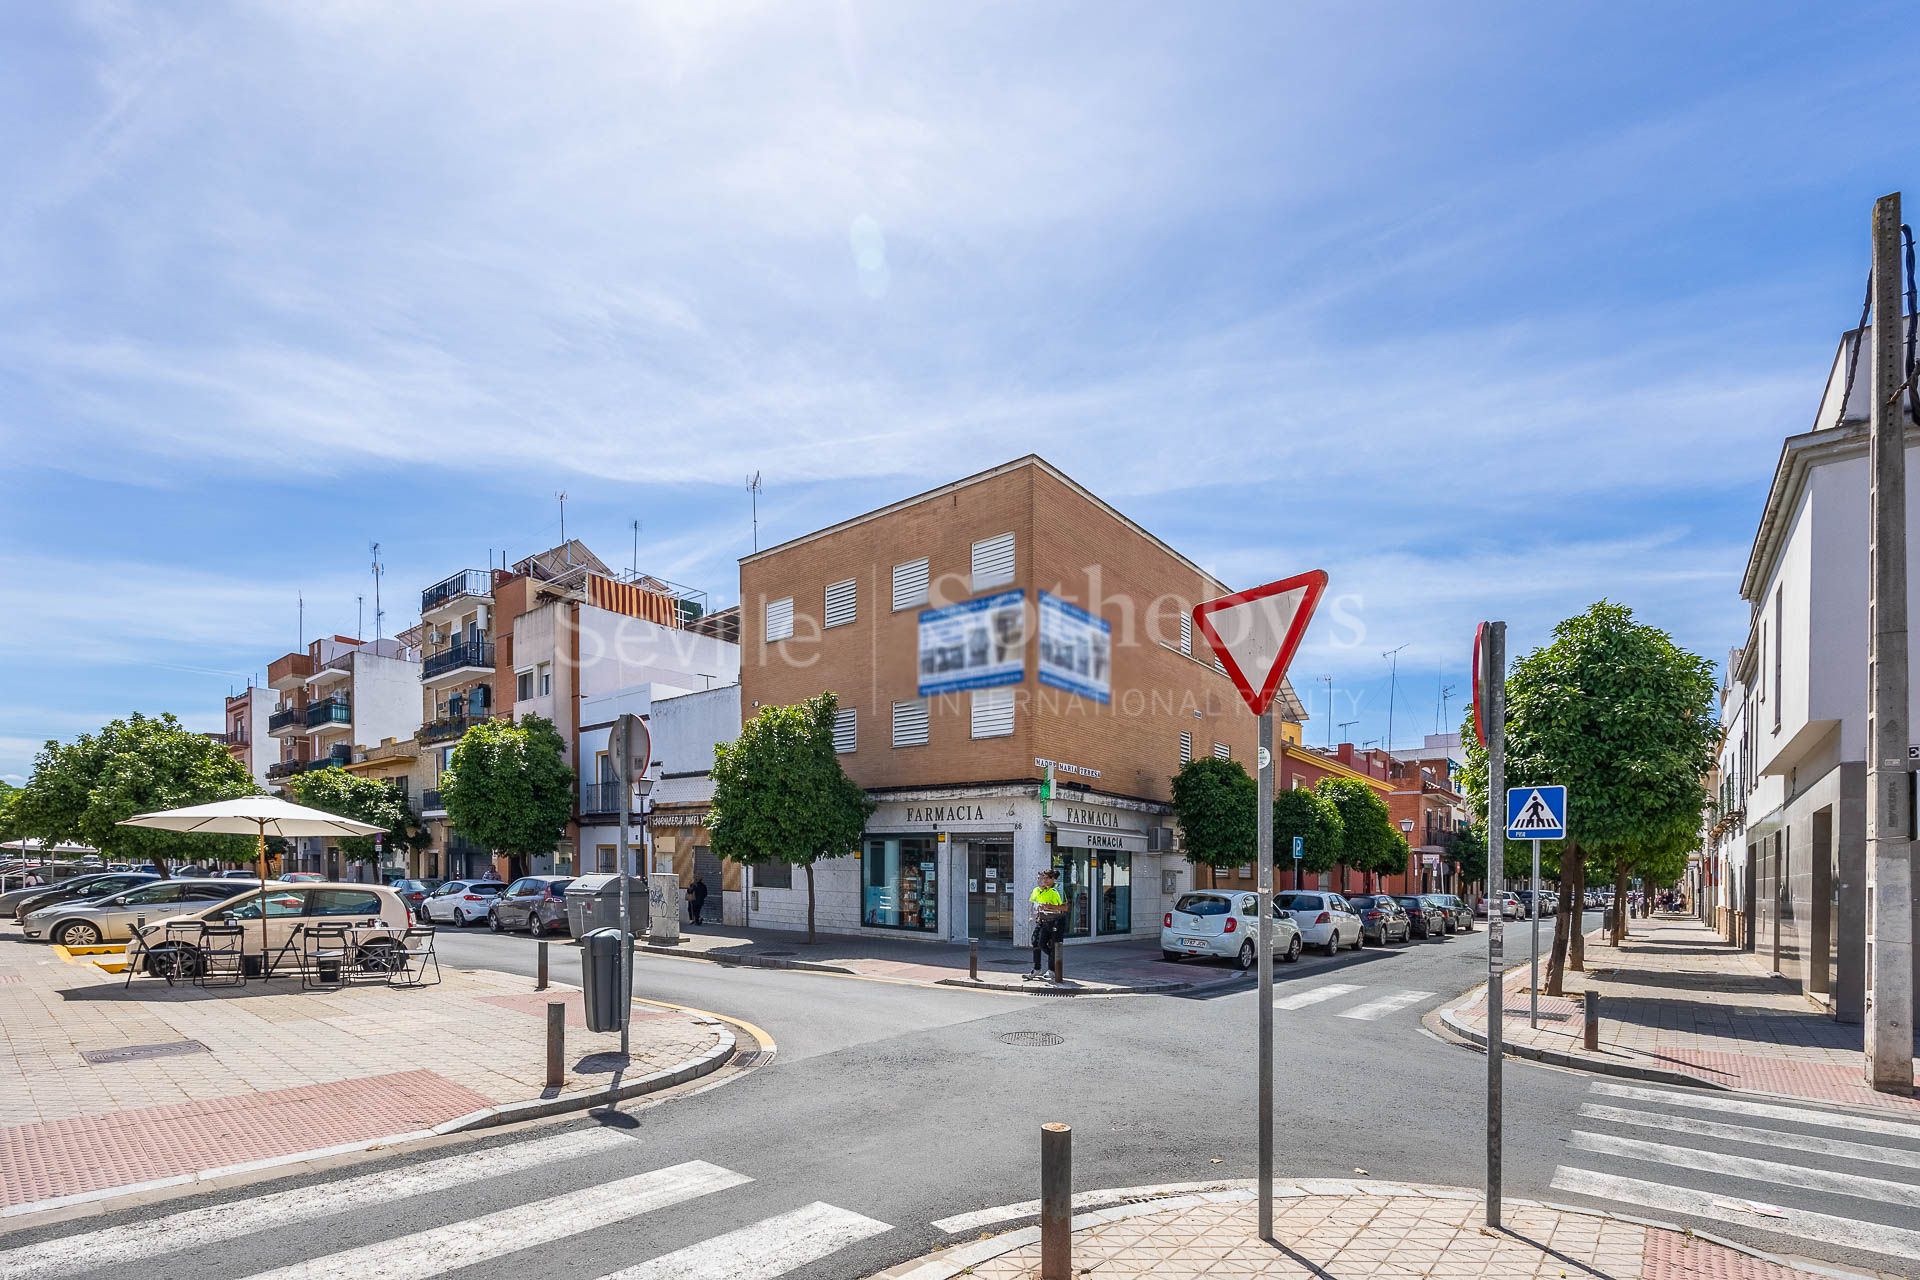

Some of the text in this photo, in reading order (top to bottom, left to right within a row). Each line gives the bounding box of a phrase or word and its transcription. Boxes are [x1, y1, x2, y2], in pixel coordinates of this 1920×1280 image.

[906, 805, 984, 822] FARMACIA
[1066, 807, 1119, 828] FARMACIA
[1087, 835, 1123, 848] FARMACIA
